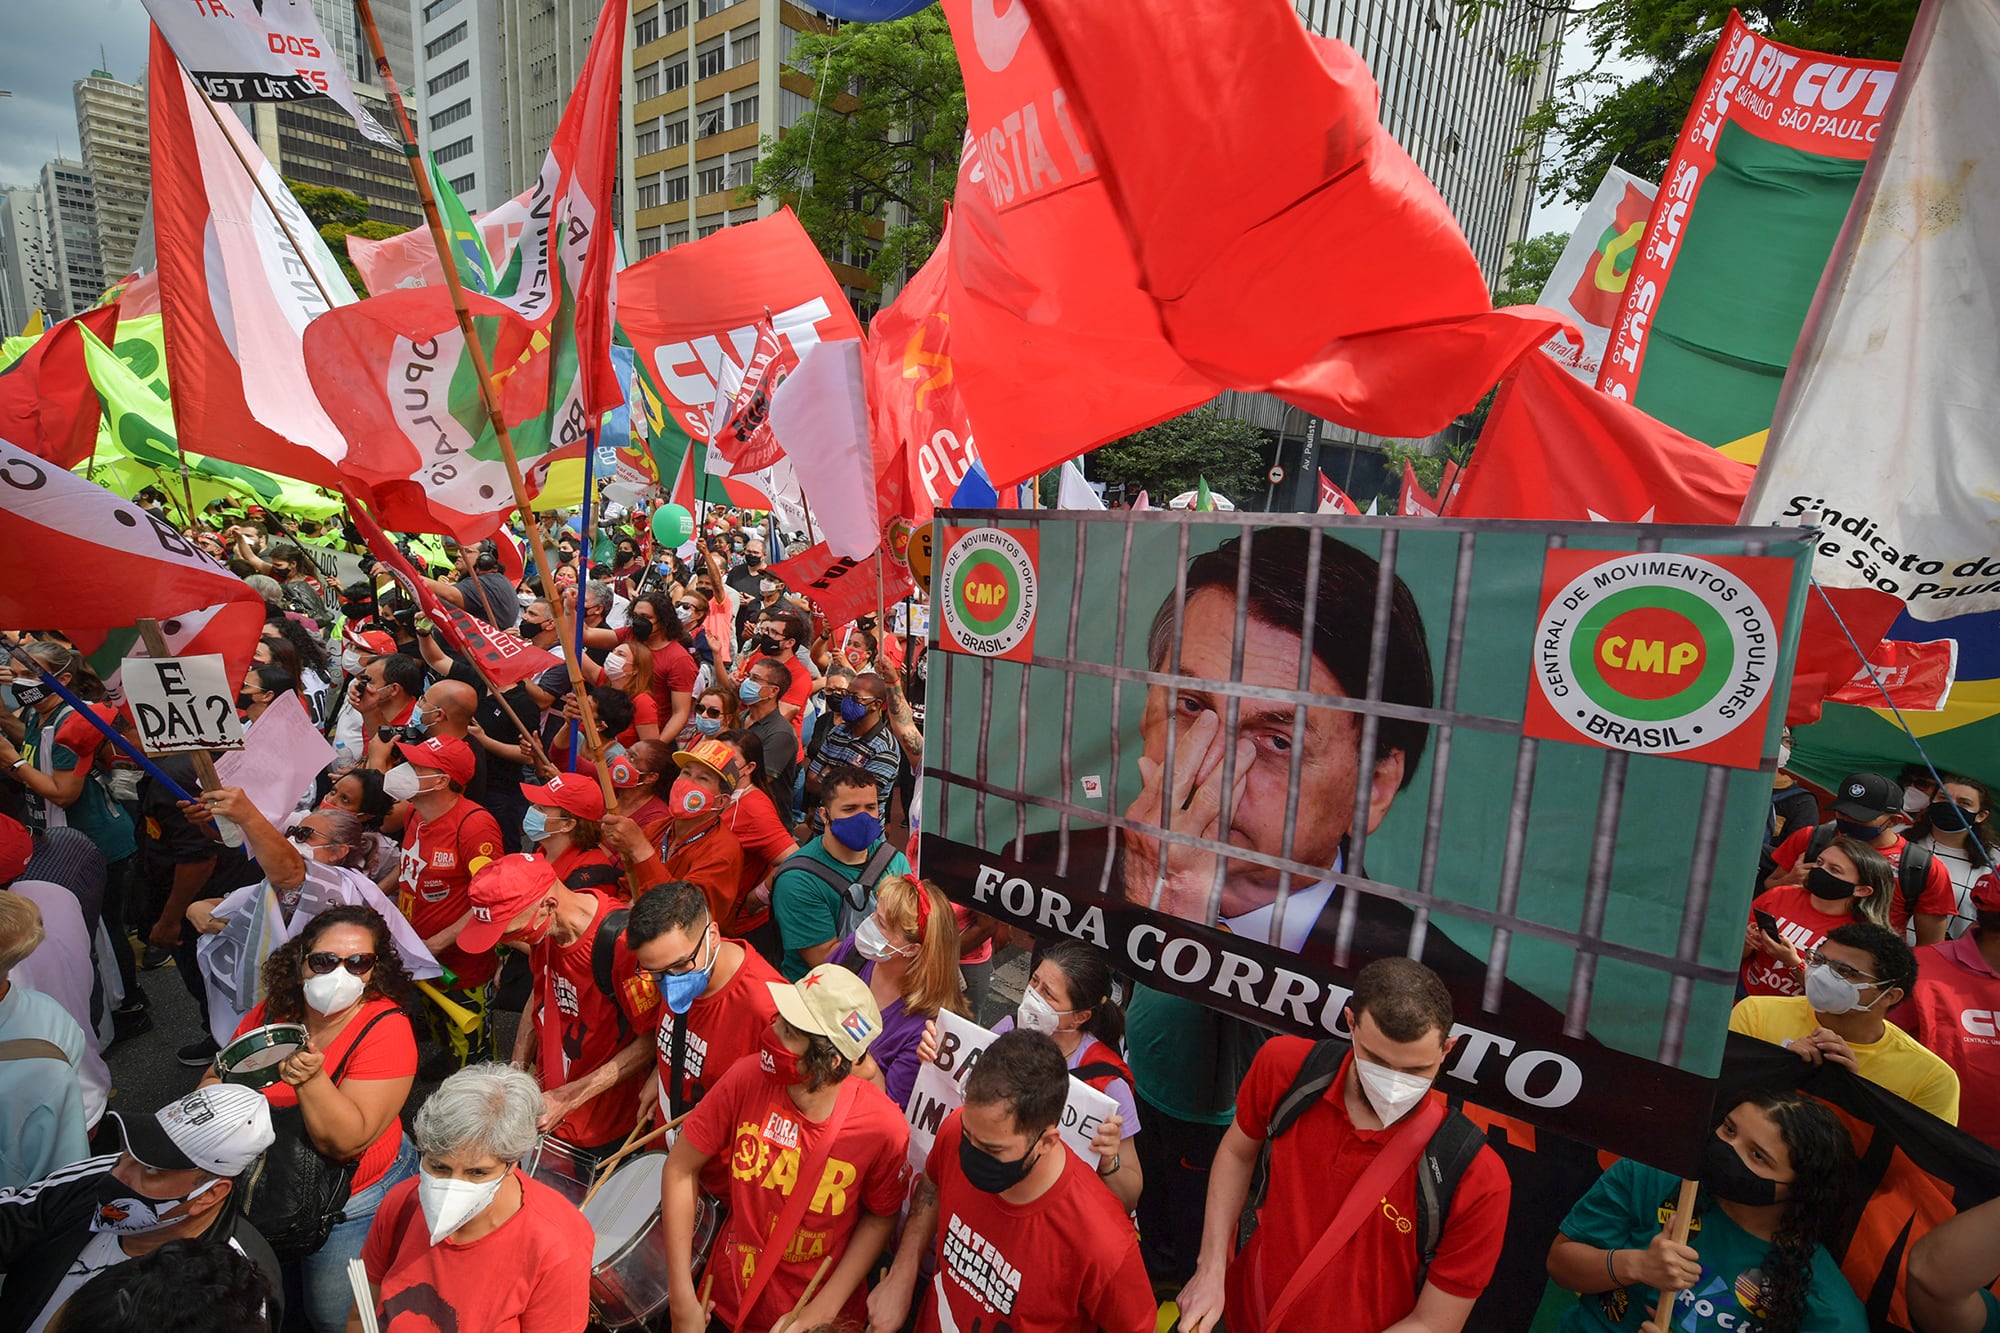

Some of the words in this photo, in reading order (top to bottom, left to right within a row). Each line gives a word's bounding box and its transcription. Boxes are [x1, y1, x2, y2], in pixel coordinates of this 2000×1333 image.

[267, 33, 321, 58] DOS
[1750, 43, 1800, 96] CUT
[253, 78, 294, 99] UGT
[1793, 63, 1898, 117] CUT
[1778, 105, 1812, 132] SÃO
[1668, 159, 1687, 198] SÃO
[1646, 202, 1669, 260] PAULO
[1655, 165, 1699, 270] CUT
[1628, 273, 1645, 309] SÃO
[1612, 311, 1629, 365] PAULO
[1622, 280, 1656, 374] CUT
[1304, 419, 1317, 455] Paulista
[943, 571, 955, 623] CENTRAL
[949, 550, 961, 567] DE
[961, 533, 1020, 558] MOVIMENTOS
[1016, 559, 1034, 632] POPULARES
[1815, 533, 1842, 558] e
[1846, 549, 1900, 594] São
[965, 581, 1006, 605] CMP
[961, 633, 1007, 653] BRASIL
[1544, 616, 1569, 698] CENTRAL
[1563, 586, 1590, 611] DE
[1593, 561, 1739, 602] MOVIMENTOS
[1719, 605, 1766, 719] POPULARES
[1601, 635, 1699, 675] CMP
[155, 662, 192, 698] E
[135, 695, 232, 742] DAÍ?
[1585, 713, 1691, 748] BRASIL
[972, 863, 1110, 951] FORA
[1126, 923, 1584, 1109] CORRUTO
[767, 1111, 799, 1141] FORA
[946, 1232, 989, 1275] ZUMBI
[989, 1269, 1014, 1302] DOS
[948, 1212, 1022, 1293] BATERIA
[943, 1242, 1011, 1315] PALMARES
